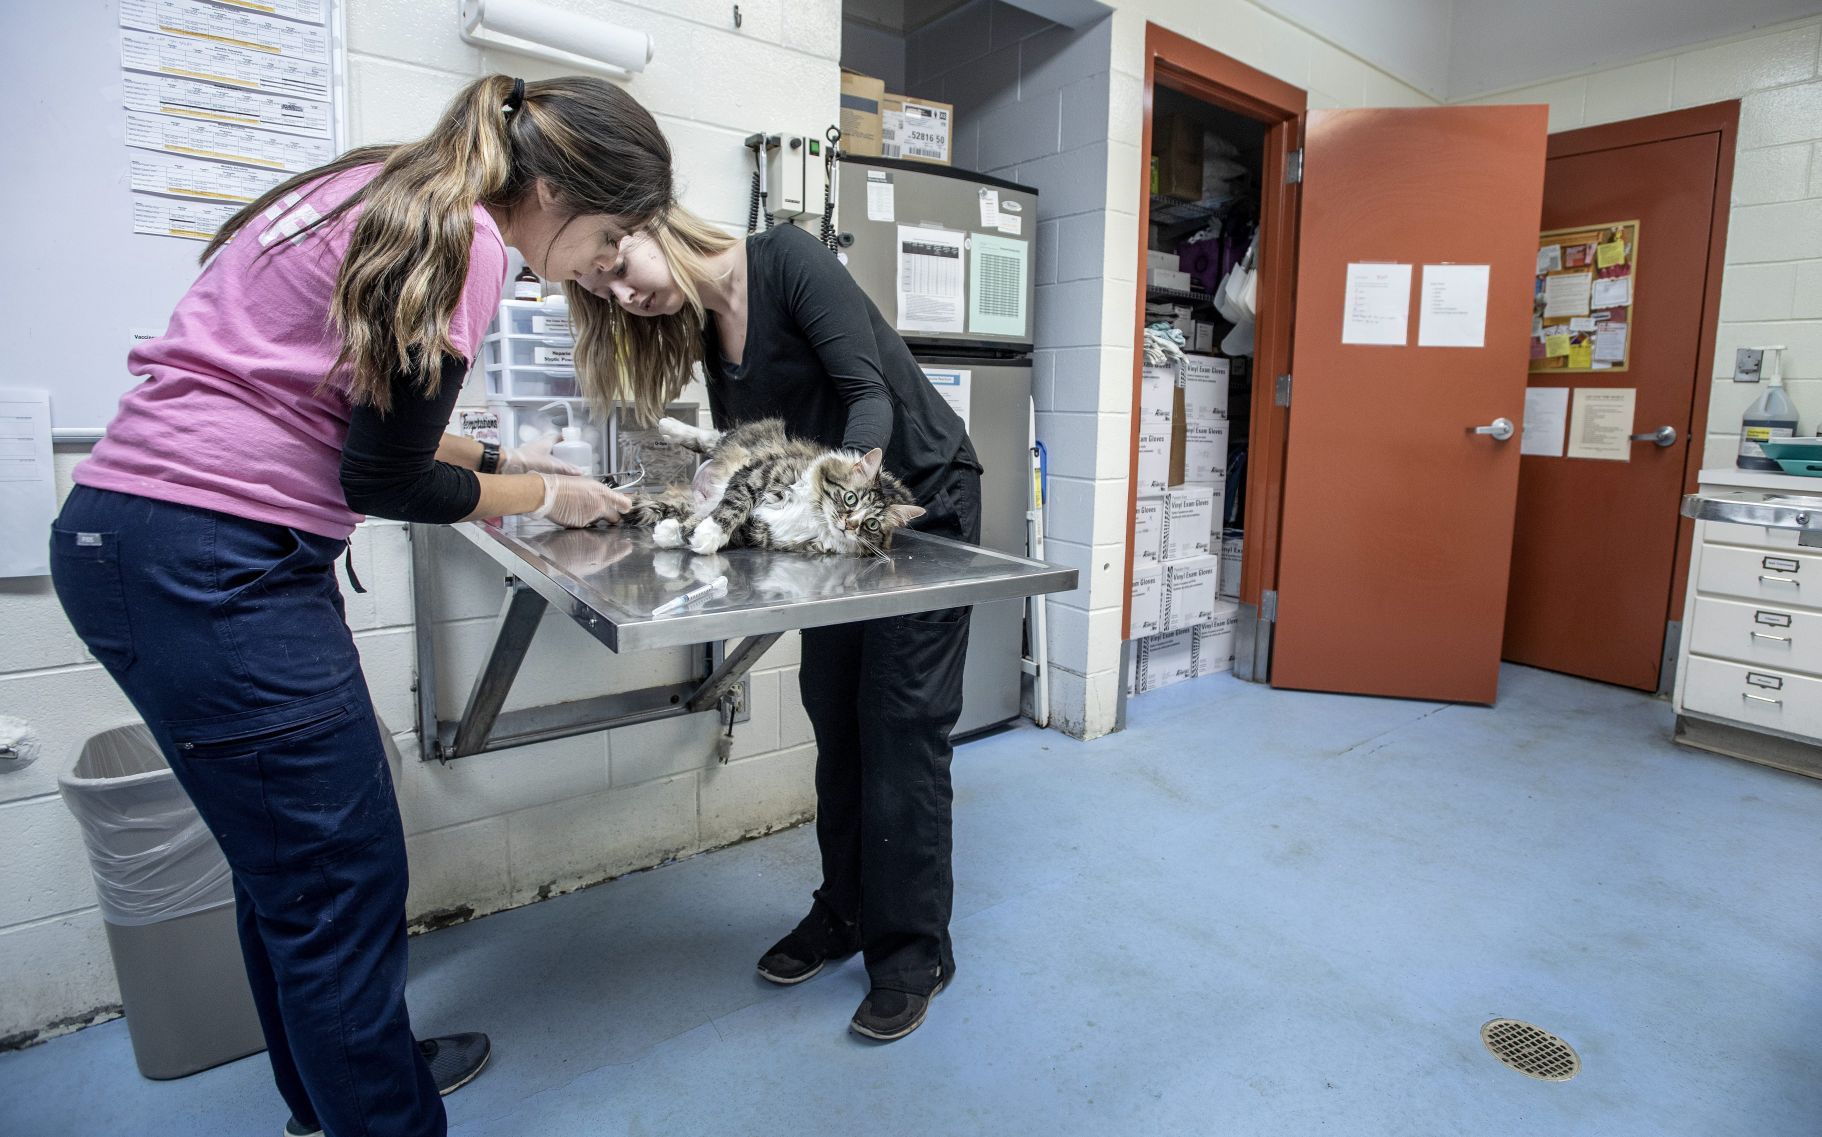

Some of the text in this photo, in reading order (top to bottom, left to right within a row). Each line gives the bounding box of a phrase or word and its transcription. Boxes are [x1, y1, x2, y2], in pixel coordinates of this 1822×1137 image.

[1211, 366, 1226, 375] Gloves
[1208, 427, 1223, 435] Gloves
[1148, 434, 1165, 442] Gloves
[1171, 501, 1183, 509] Vinyl
[1183, 500, 1195, 508] Exam
[1141, 506, 1156, 514] Gloves
[1173, 572, 1186, 580] Vinyl
[1198, 568, 1213, 577] Gloves
[1140, 578, 1156, 586] Gloves
[1175, 628, 1190, 637] Gloves
